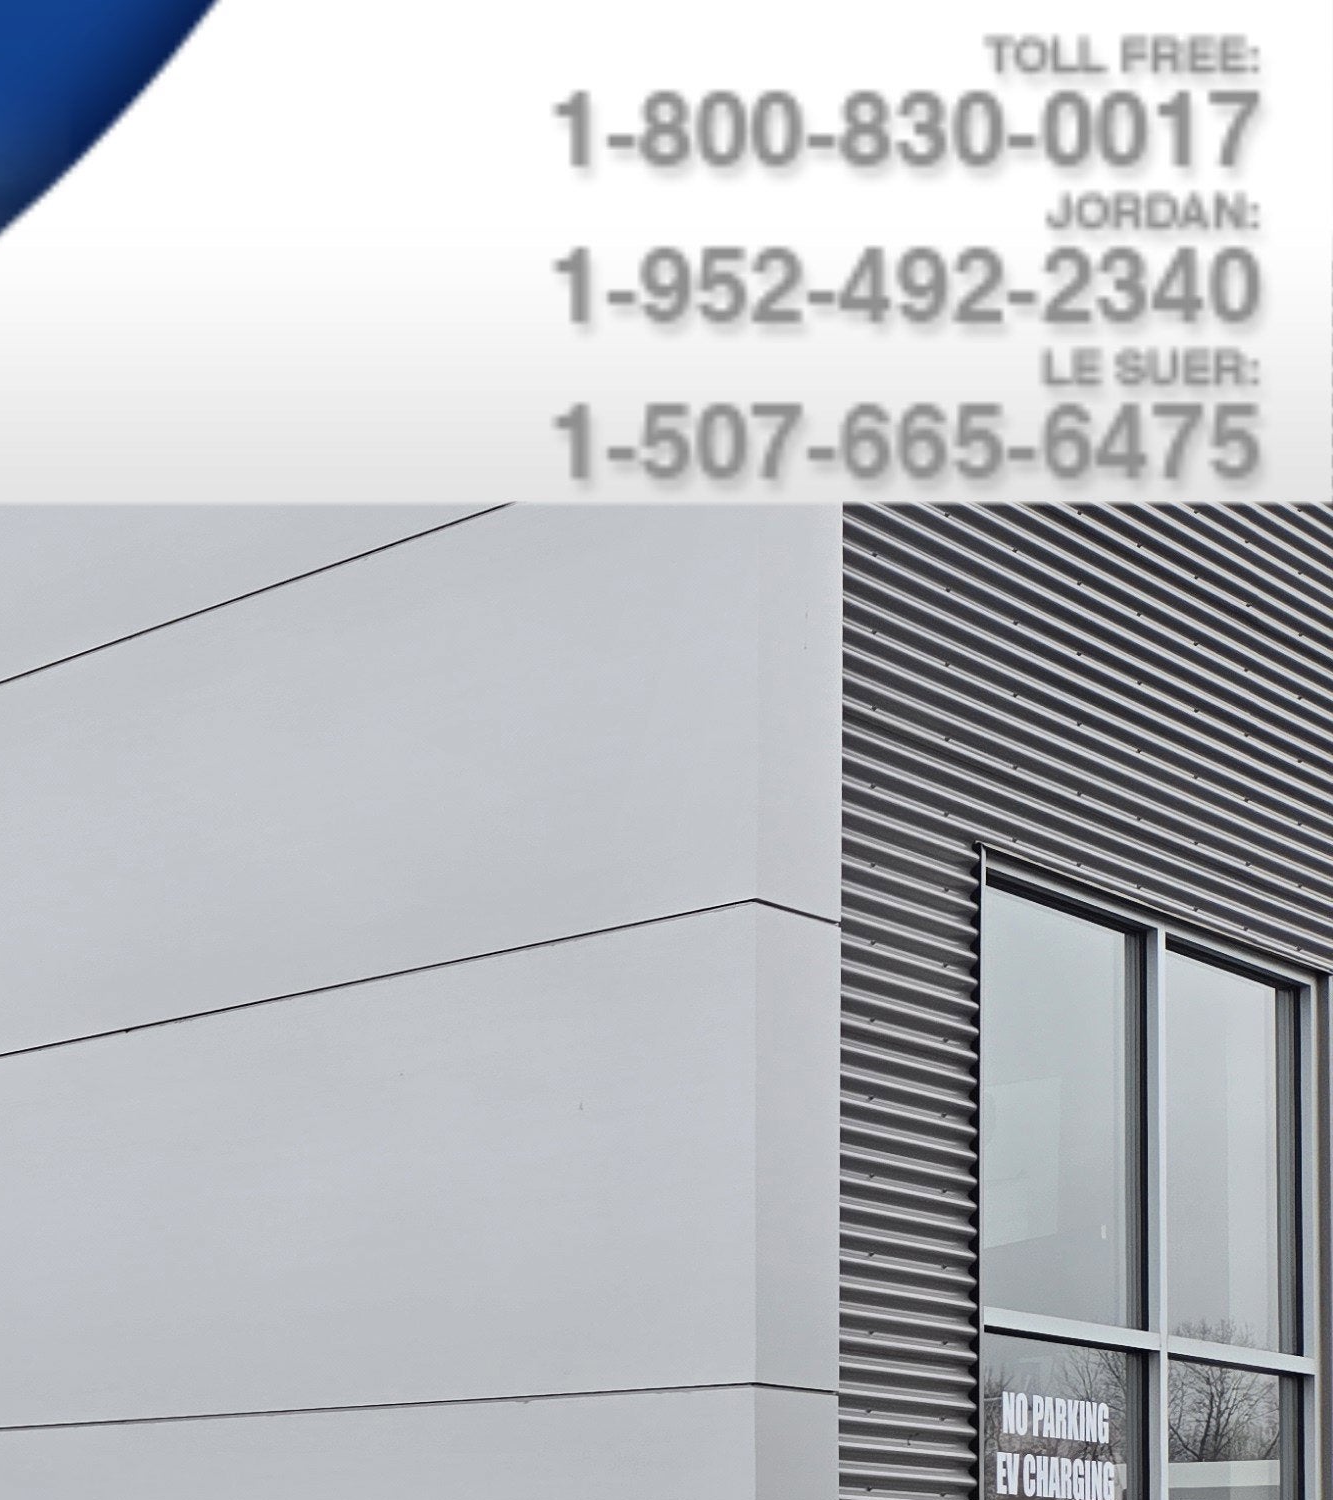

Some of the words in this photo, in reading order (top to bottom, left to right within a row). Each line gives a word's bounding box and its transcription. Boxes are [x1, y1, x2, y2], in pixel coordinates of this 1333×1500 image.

[1002, 1391, 1028, 1436] NO
[1033, 1394, 1110, 1444] PARKING
[996, 1452, 1020, 1495] EV
